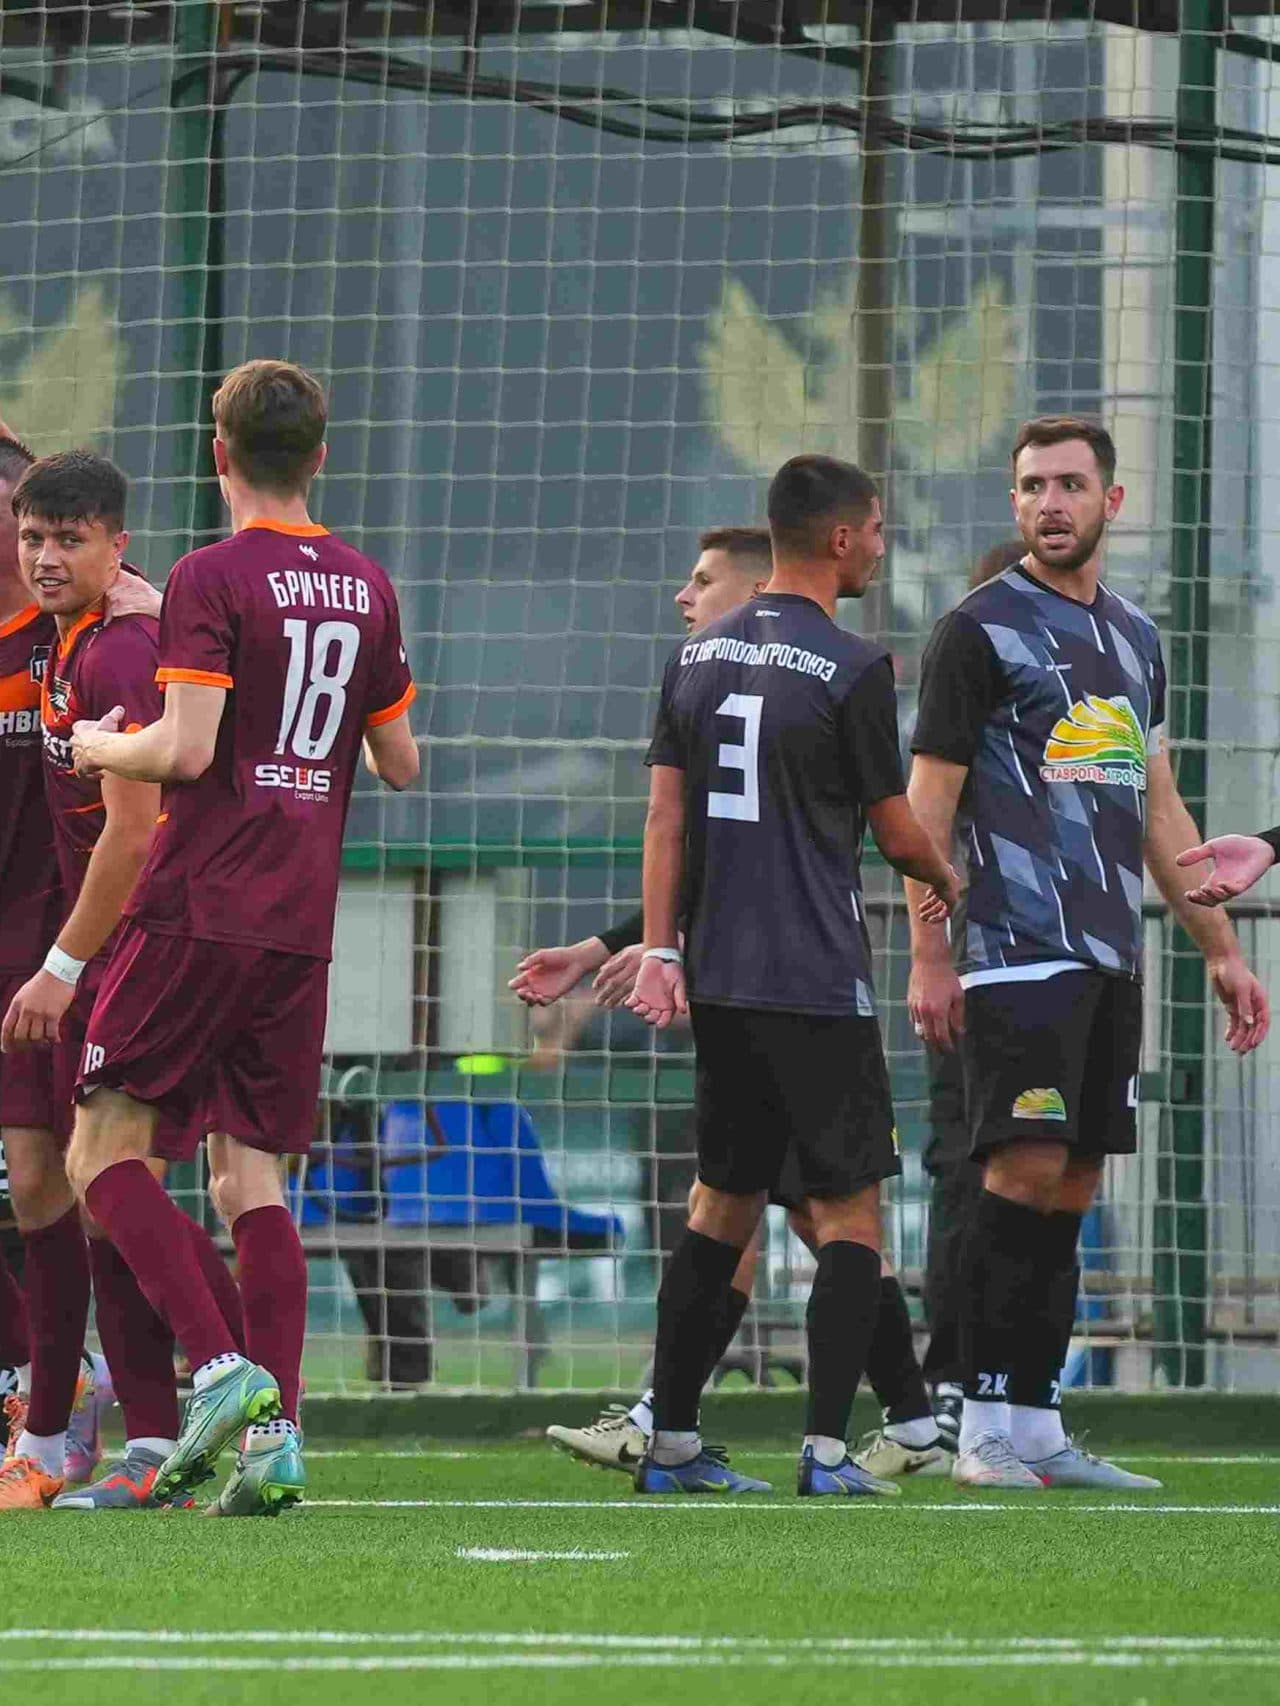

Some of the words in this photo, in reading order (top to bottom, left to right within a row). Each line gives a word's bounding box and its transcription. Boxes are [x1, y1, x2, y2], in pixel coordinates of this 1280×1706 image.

[267, 570, 370, 615] БРИЧЕЕВ
[273, 618, 360, 760] 18
[255, 764, 331, 792] SEUS
[707, 693, 764, 822] 3
